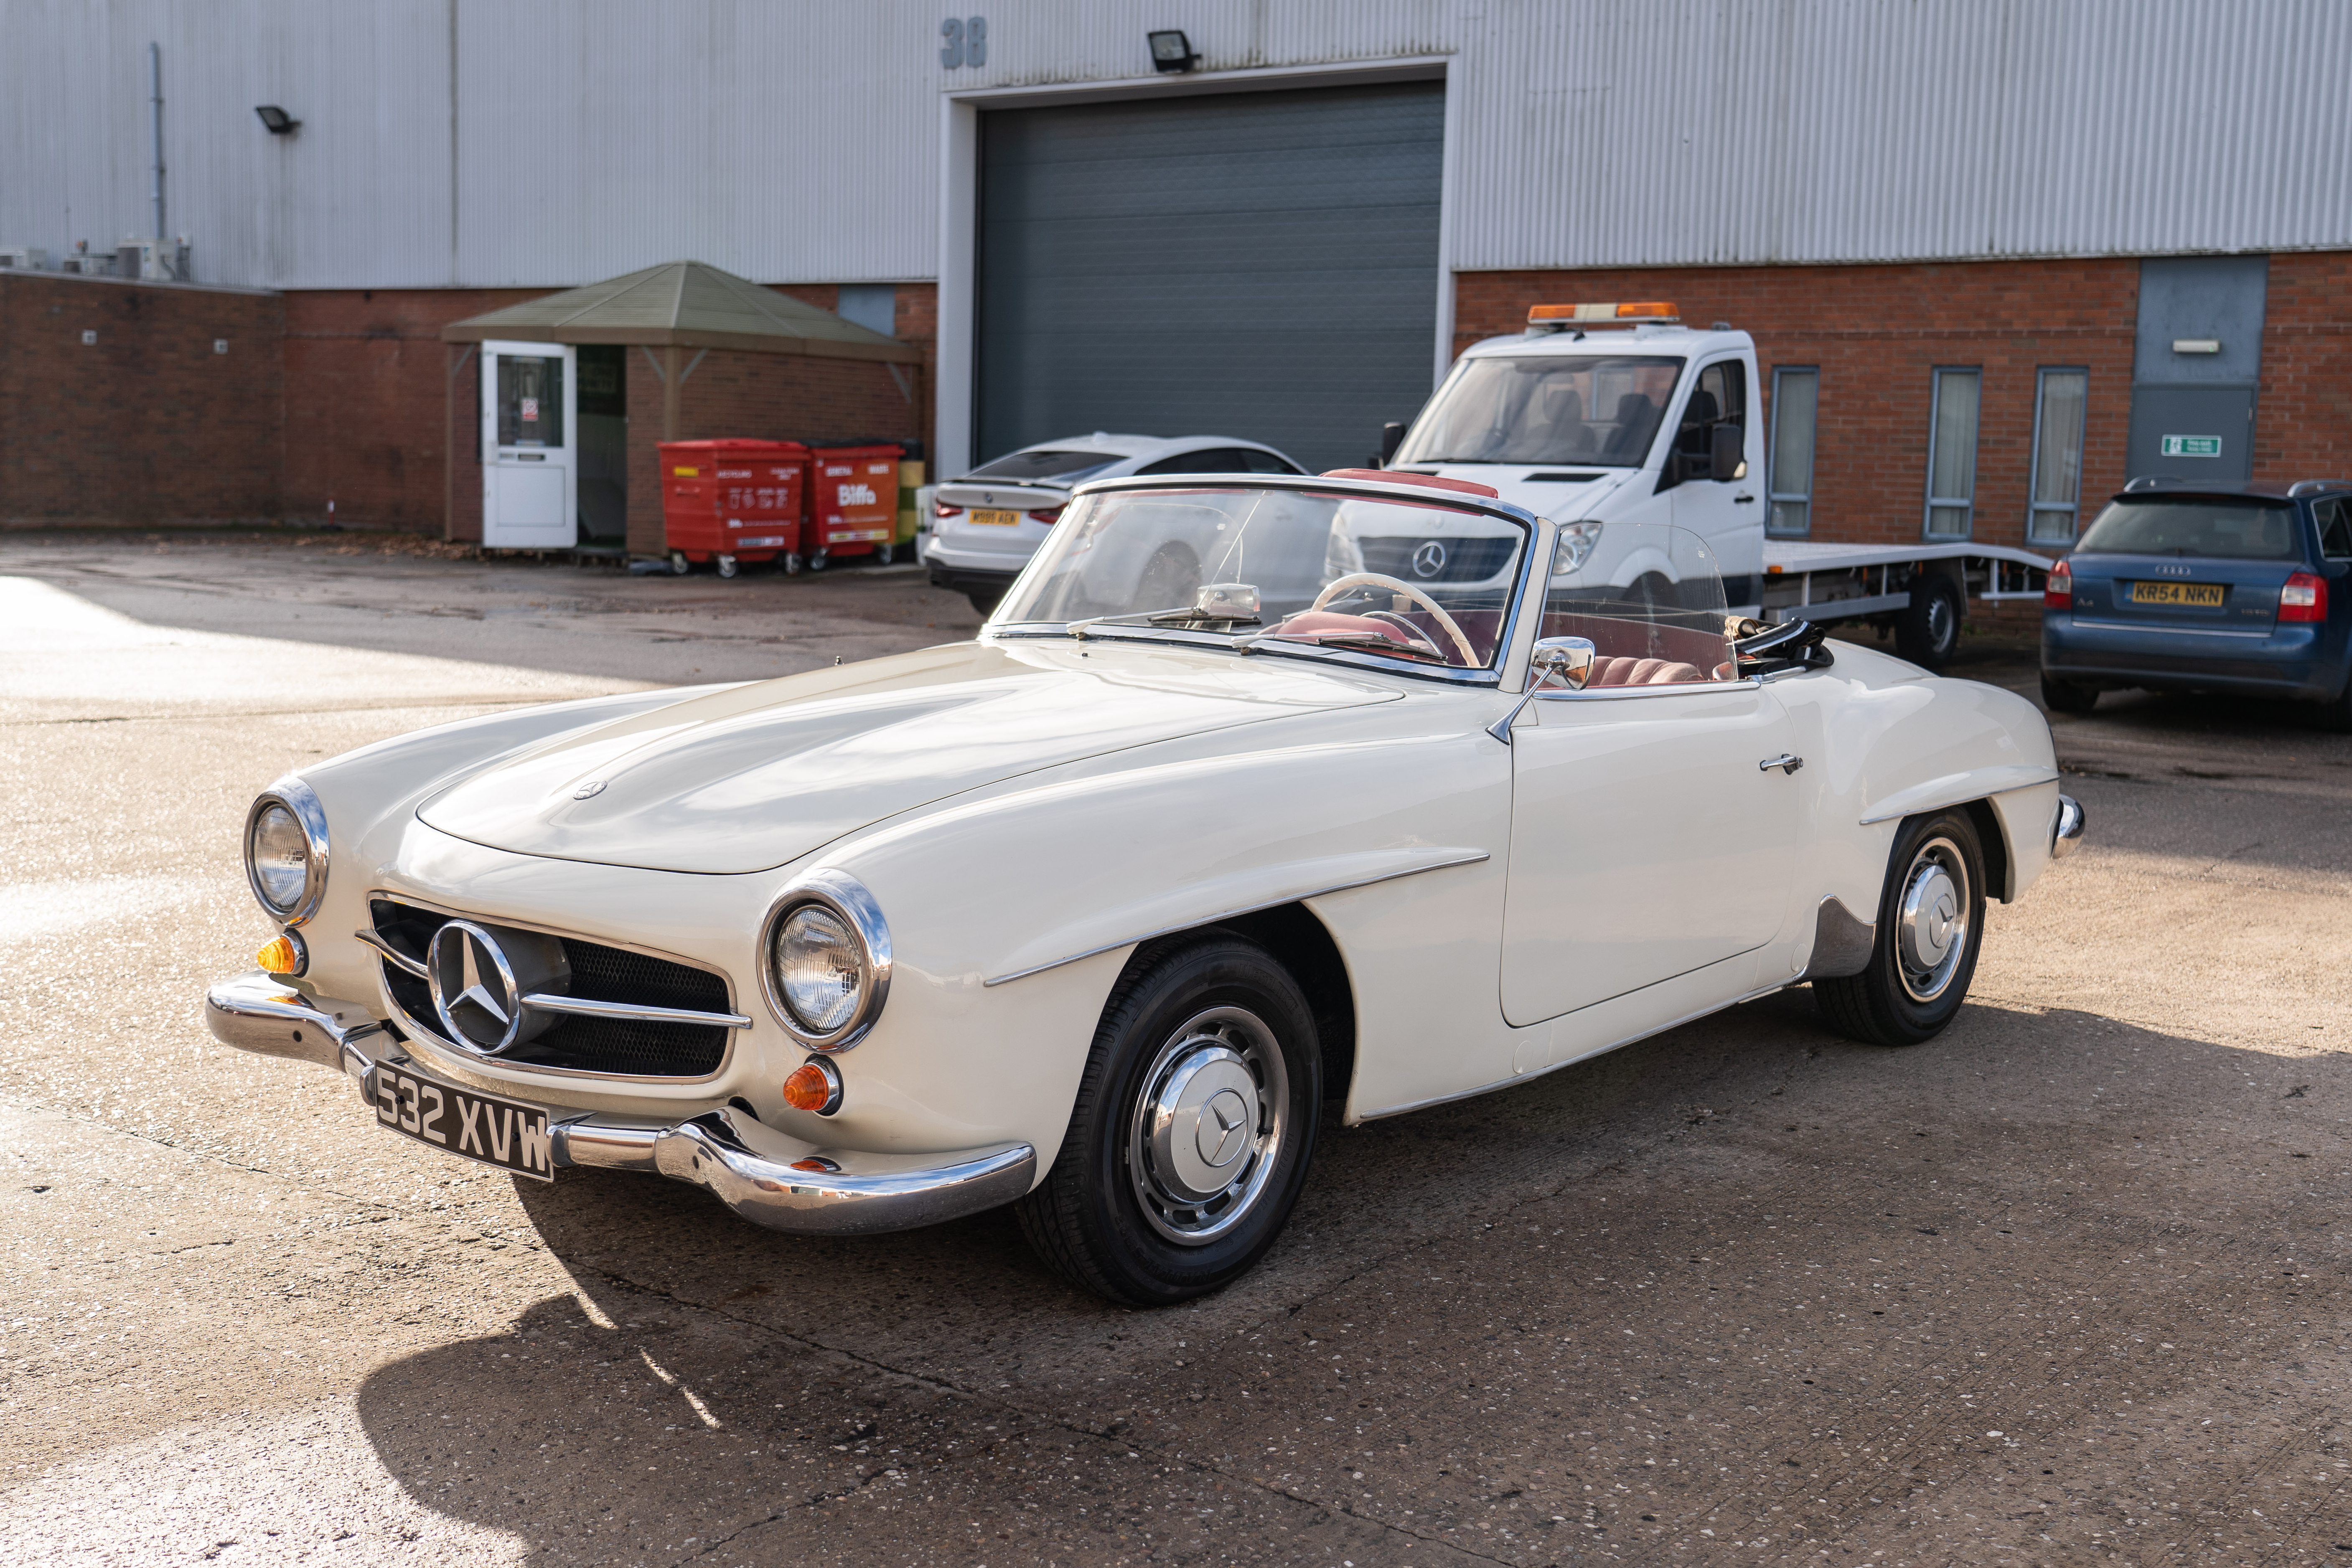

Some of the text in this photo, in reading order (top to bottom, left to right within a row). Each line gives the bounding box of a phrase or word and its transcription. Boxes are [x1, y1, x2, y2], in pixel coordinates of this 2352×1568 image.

[942, 17, 987, 69] 38
[837, 483, 876, 507] Biffa
[2136, 585, 2220, 603] KR54 NKN
[1236, 963, 1298, 1014] WESTLAKE
[377, 1067, 545, 1171] 532 XVW
